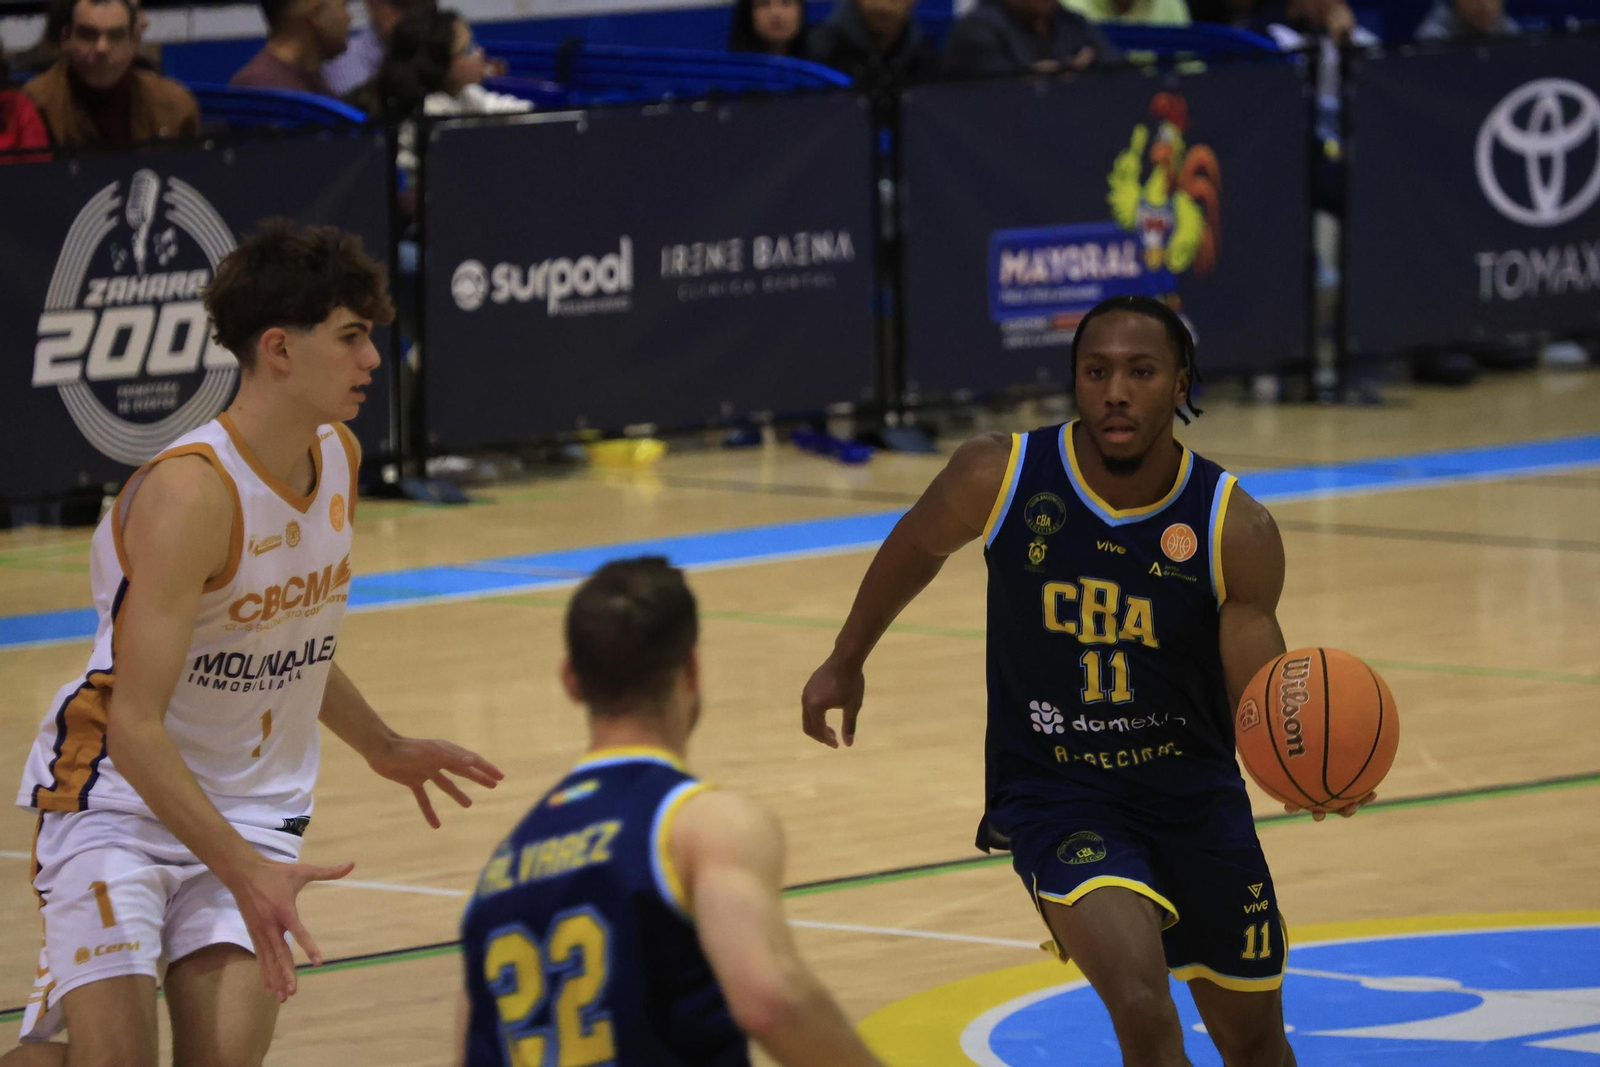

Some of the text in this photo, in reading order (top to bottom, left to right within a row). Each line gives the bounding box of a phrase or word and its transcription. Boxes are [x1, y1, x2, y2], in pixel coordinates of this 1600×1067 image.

[491, 234, 633, 317] surpool
[661, 229, 855, 279] IRENE BAENA
[999, 240, 1141, 286] MAYORAL
[84, 269, 210, 307] ZAHARA
[1036, 514, 1051, 527] CBA
[1096, 540, 1127, 555] vive
[228, 564, 333, 623] CBCM
[1041, 576, 1160, 649] CBA
[1079, 649, 1134, 705] 11
[1280, 655, 1312, 759] Wilson
[251, 708, 272, 757] 1
[88, 880, 117, 929] 1
[1243, 899, 1269, 914] vive
[95, 940, 141, 957] Cervi
[1240, 919, 1272, 960] 11
[484, 904, 617, 1067] 22
